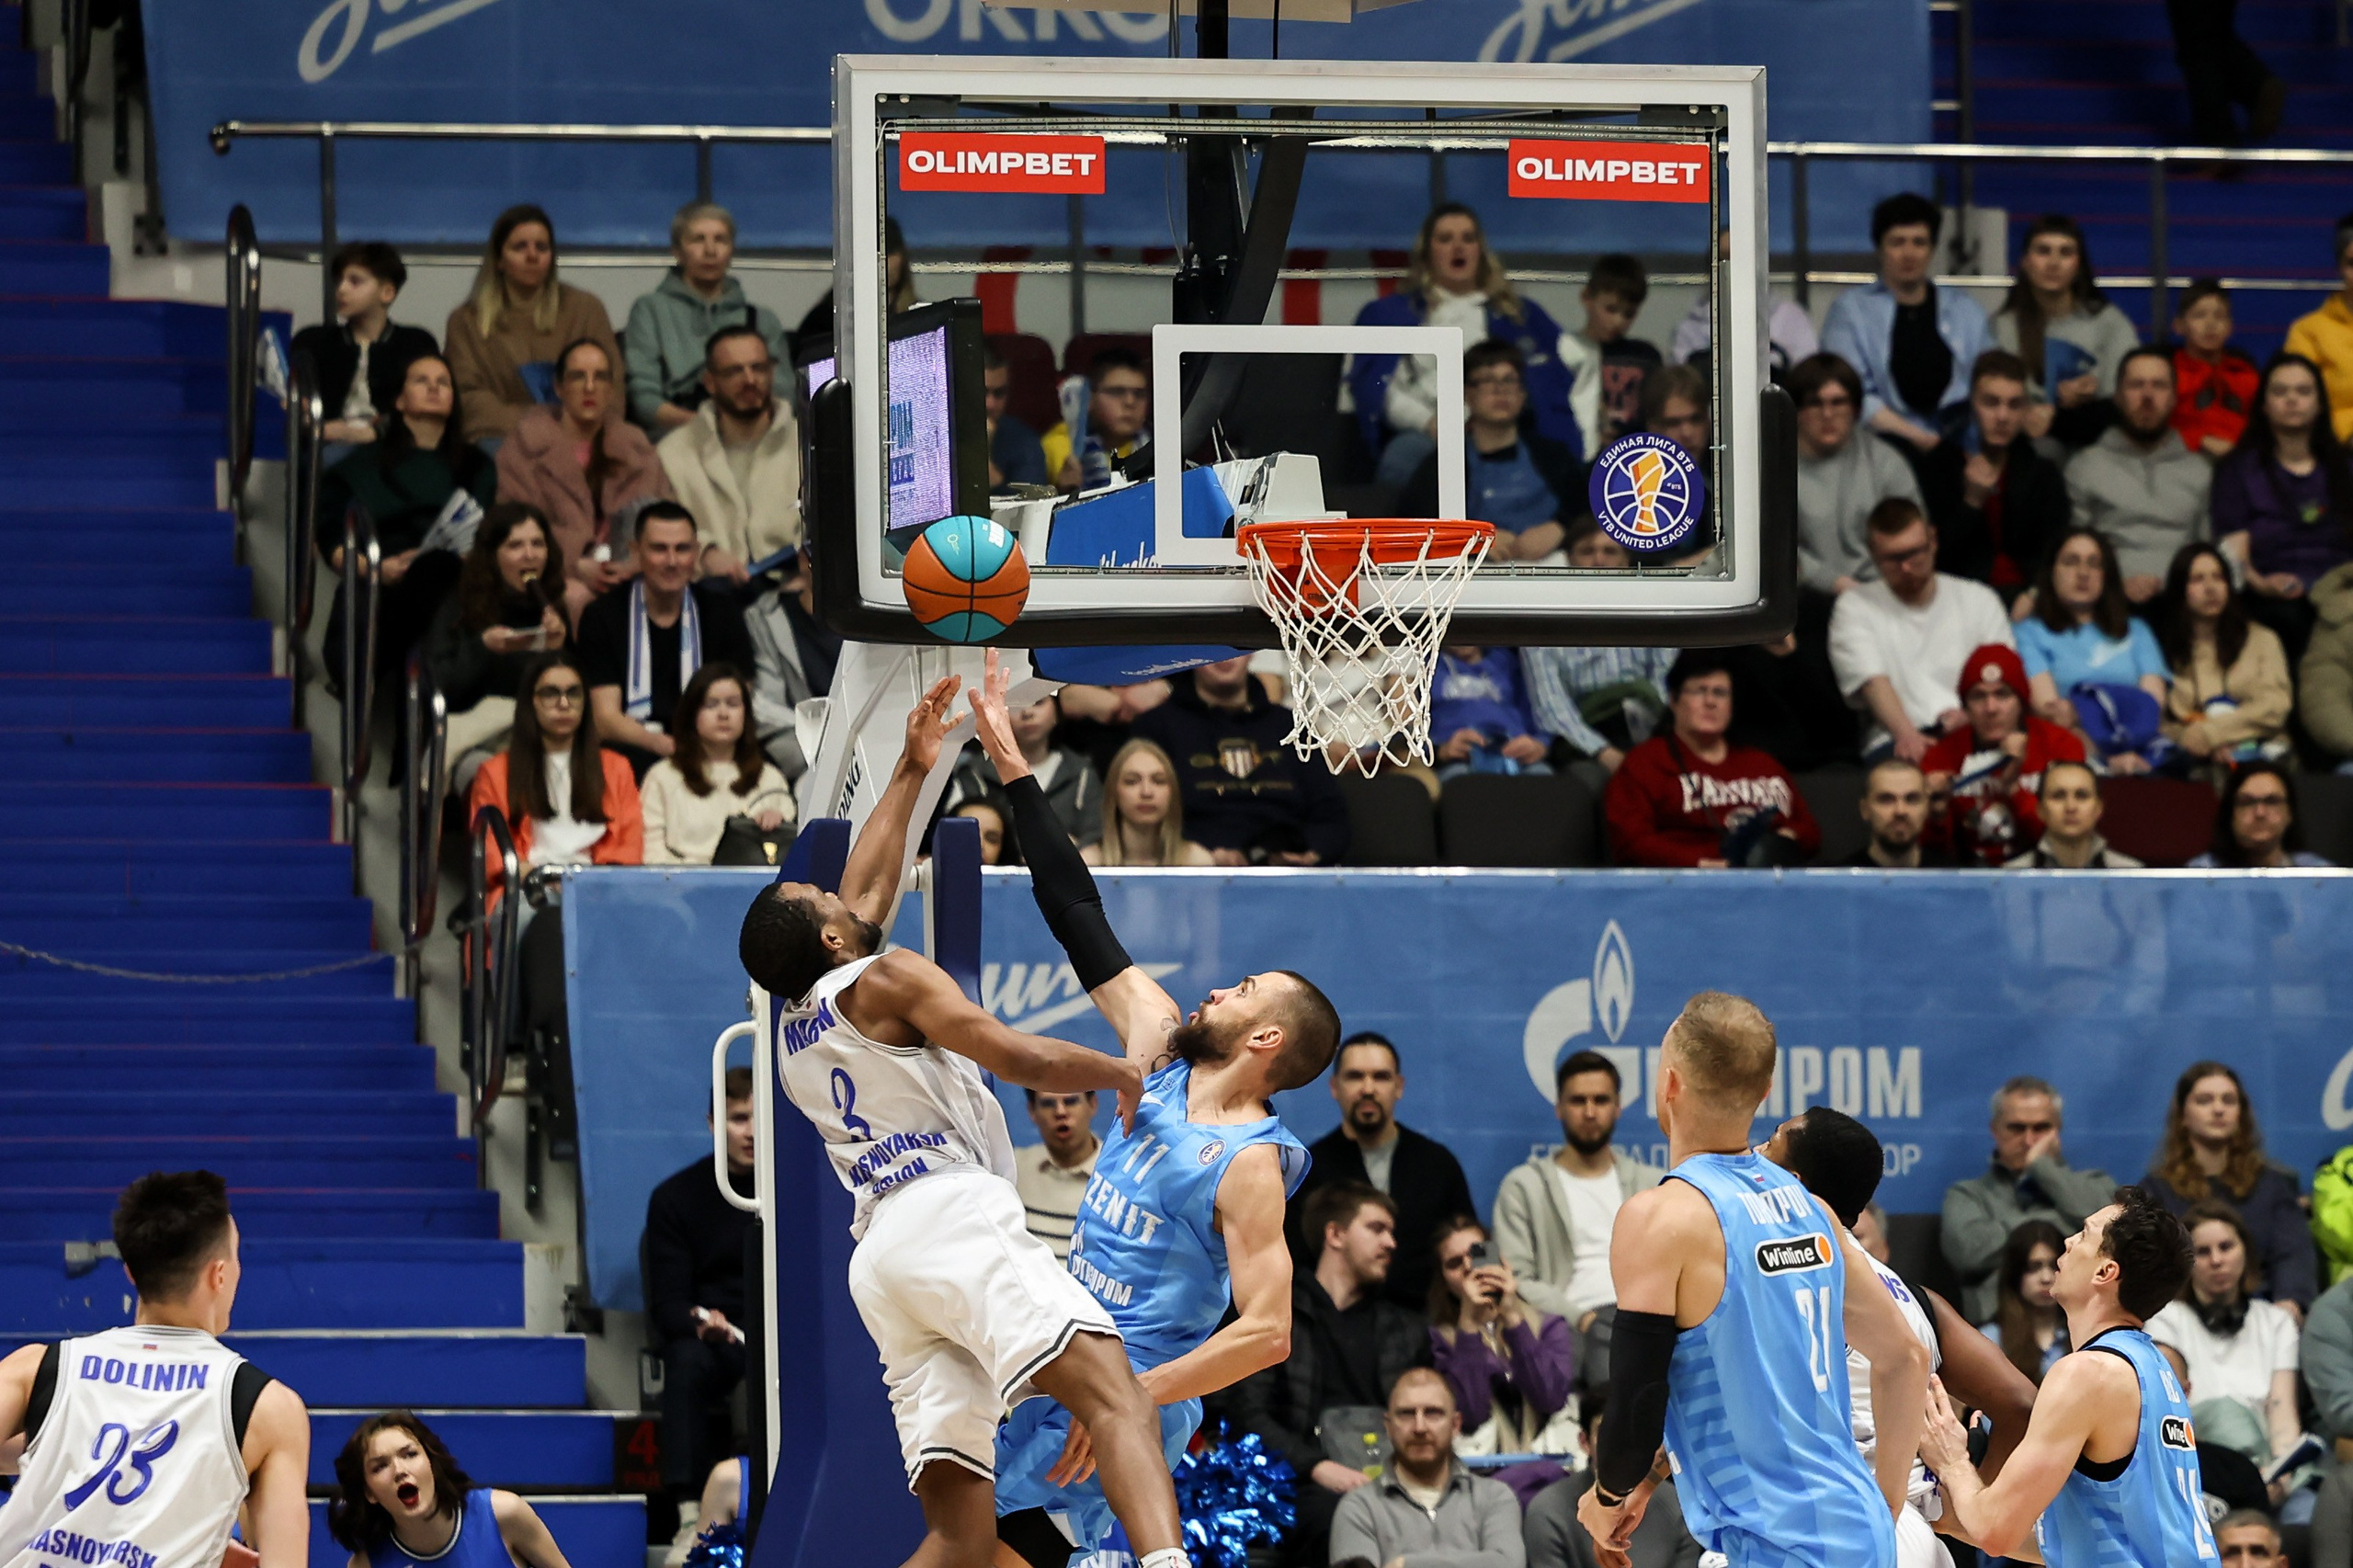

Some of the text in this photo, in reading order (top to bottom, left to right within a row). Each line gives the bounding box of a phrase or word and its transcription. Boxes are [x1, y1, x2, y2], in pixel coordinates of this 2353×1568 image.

[907, 150, 1097, 176] OLIMPBET
[1517, 157, 1702, 185] OLIMPBET
[1599, 436, 1695, 473] ЕДИНАЯ ЛИГА ВТБ
[1597, 510, 1695, 549] VTB UNITED LEAGUE
[1121, 1133, 1172, 1185] 11
[1085, 1170, 1165, 1246] ZENIT
[1761, 1245, 1815, 1268] Winline
[80, 1355, 210, 1392] DOLININ
[628, 1419, 660, 1467] 4
